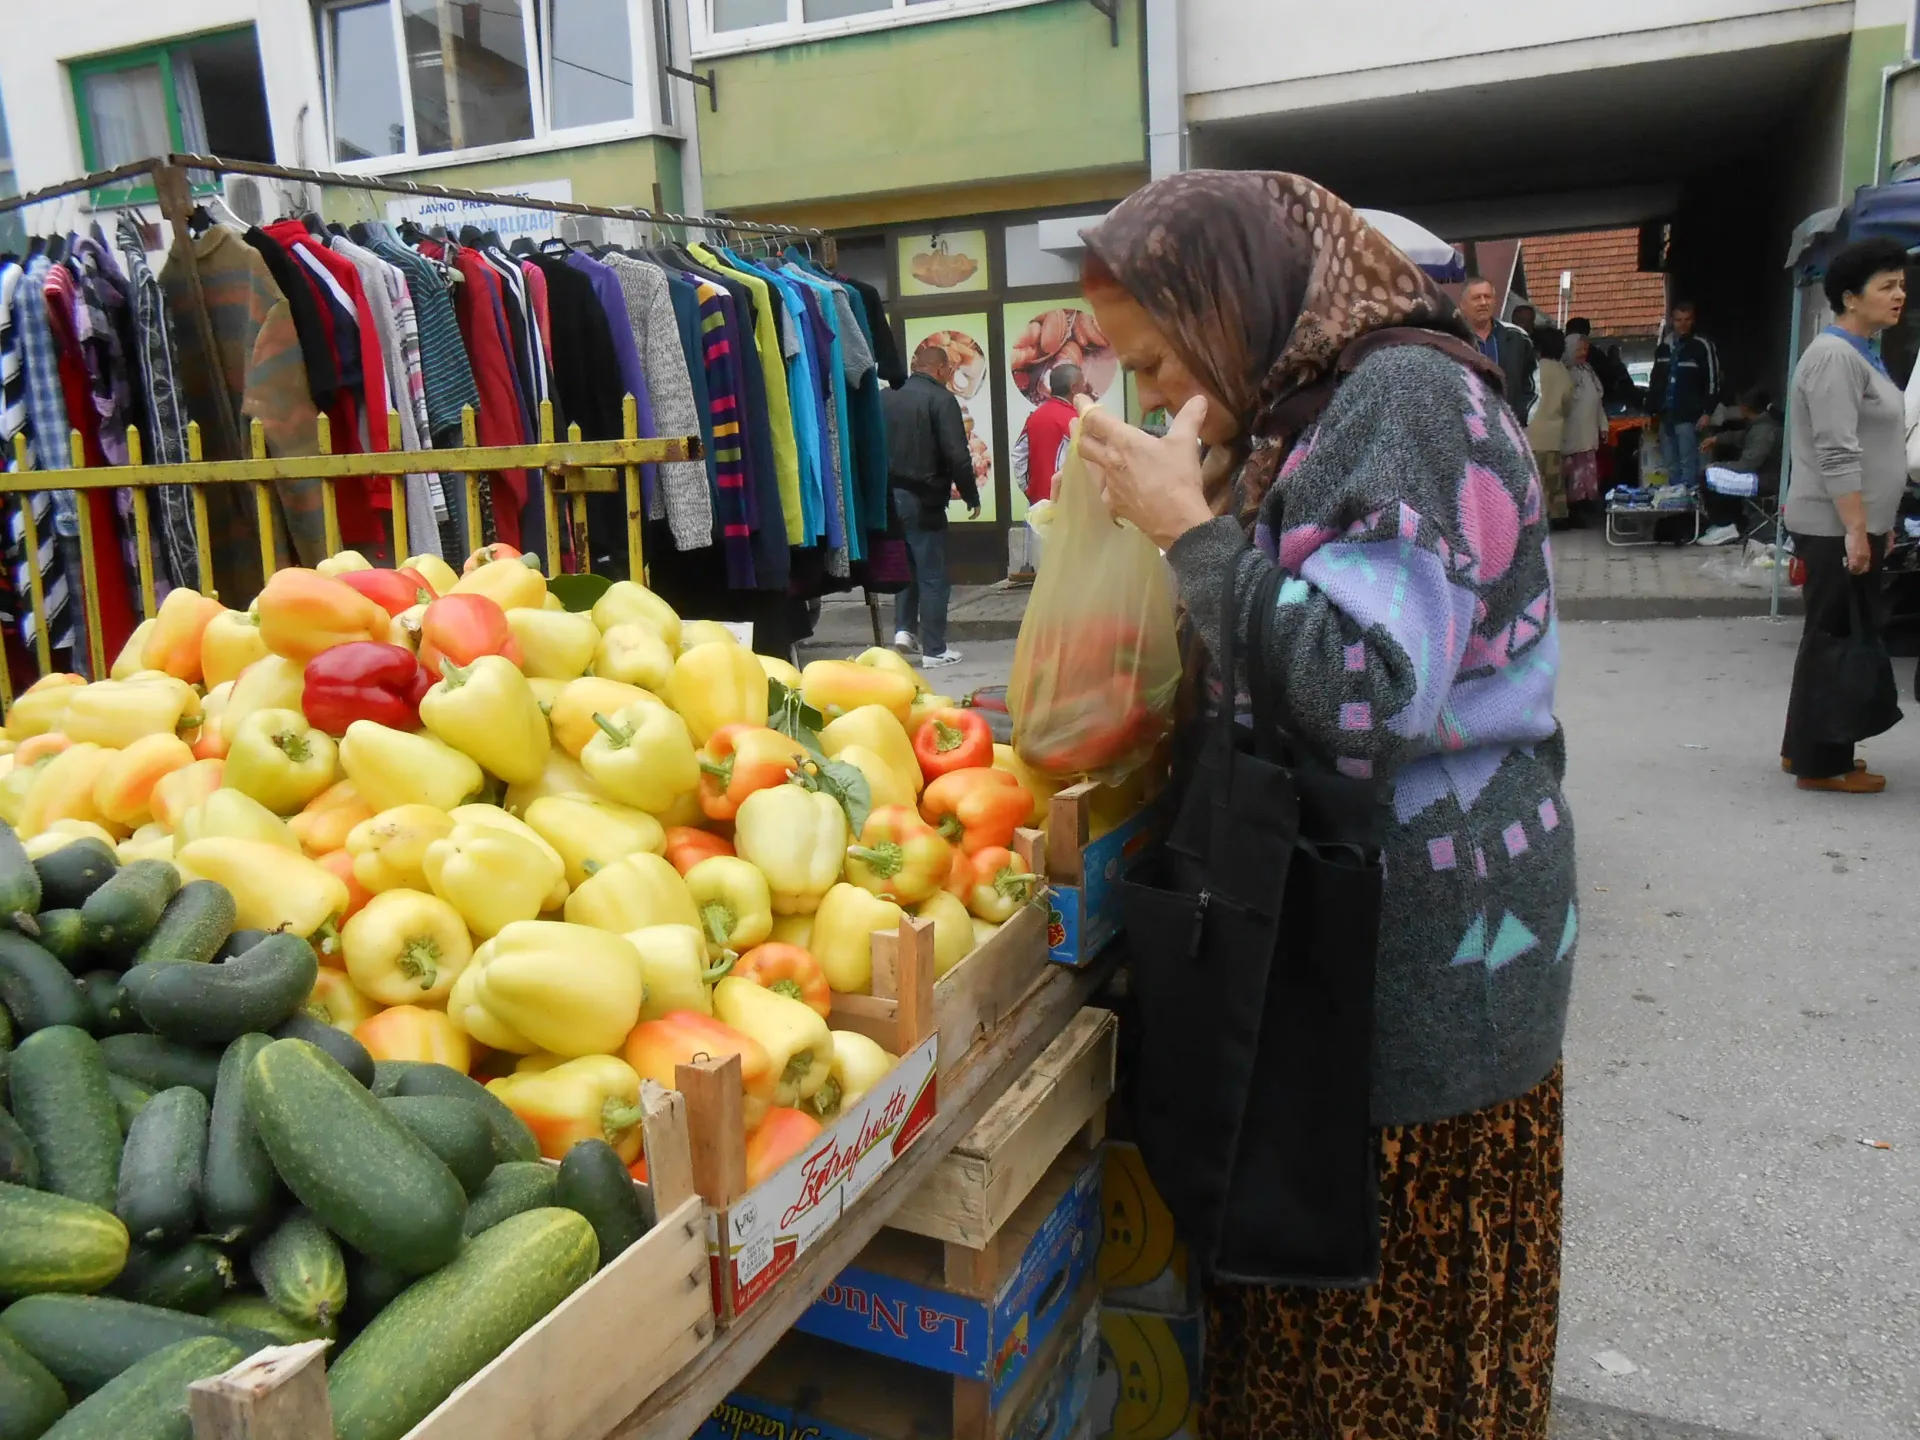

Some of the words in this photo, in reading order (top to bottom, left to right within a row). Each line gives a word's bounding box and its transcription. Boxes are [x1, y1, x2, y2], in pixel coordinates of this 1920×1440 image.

[419, 202, 455, 215] JAVNO
[820, 1281, 908, 1340] Nuo
[915, 1305, 969, 1356] La
